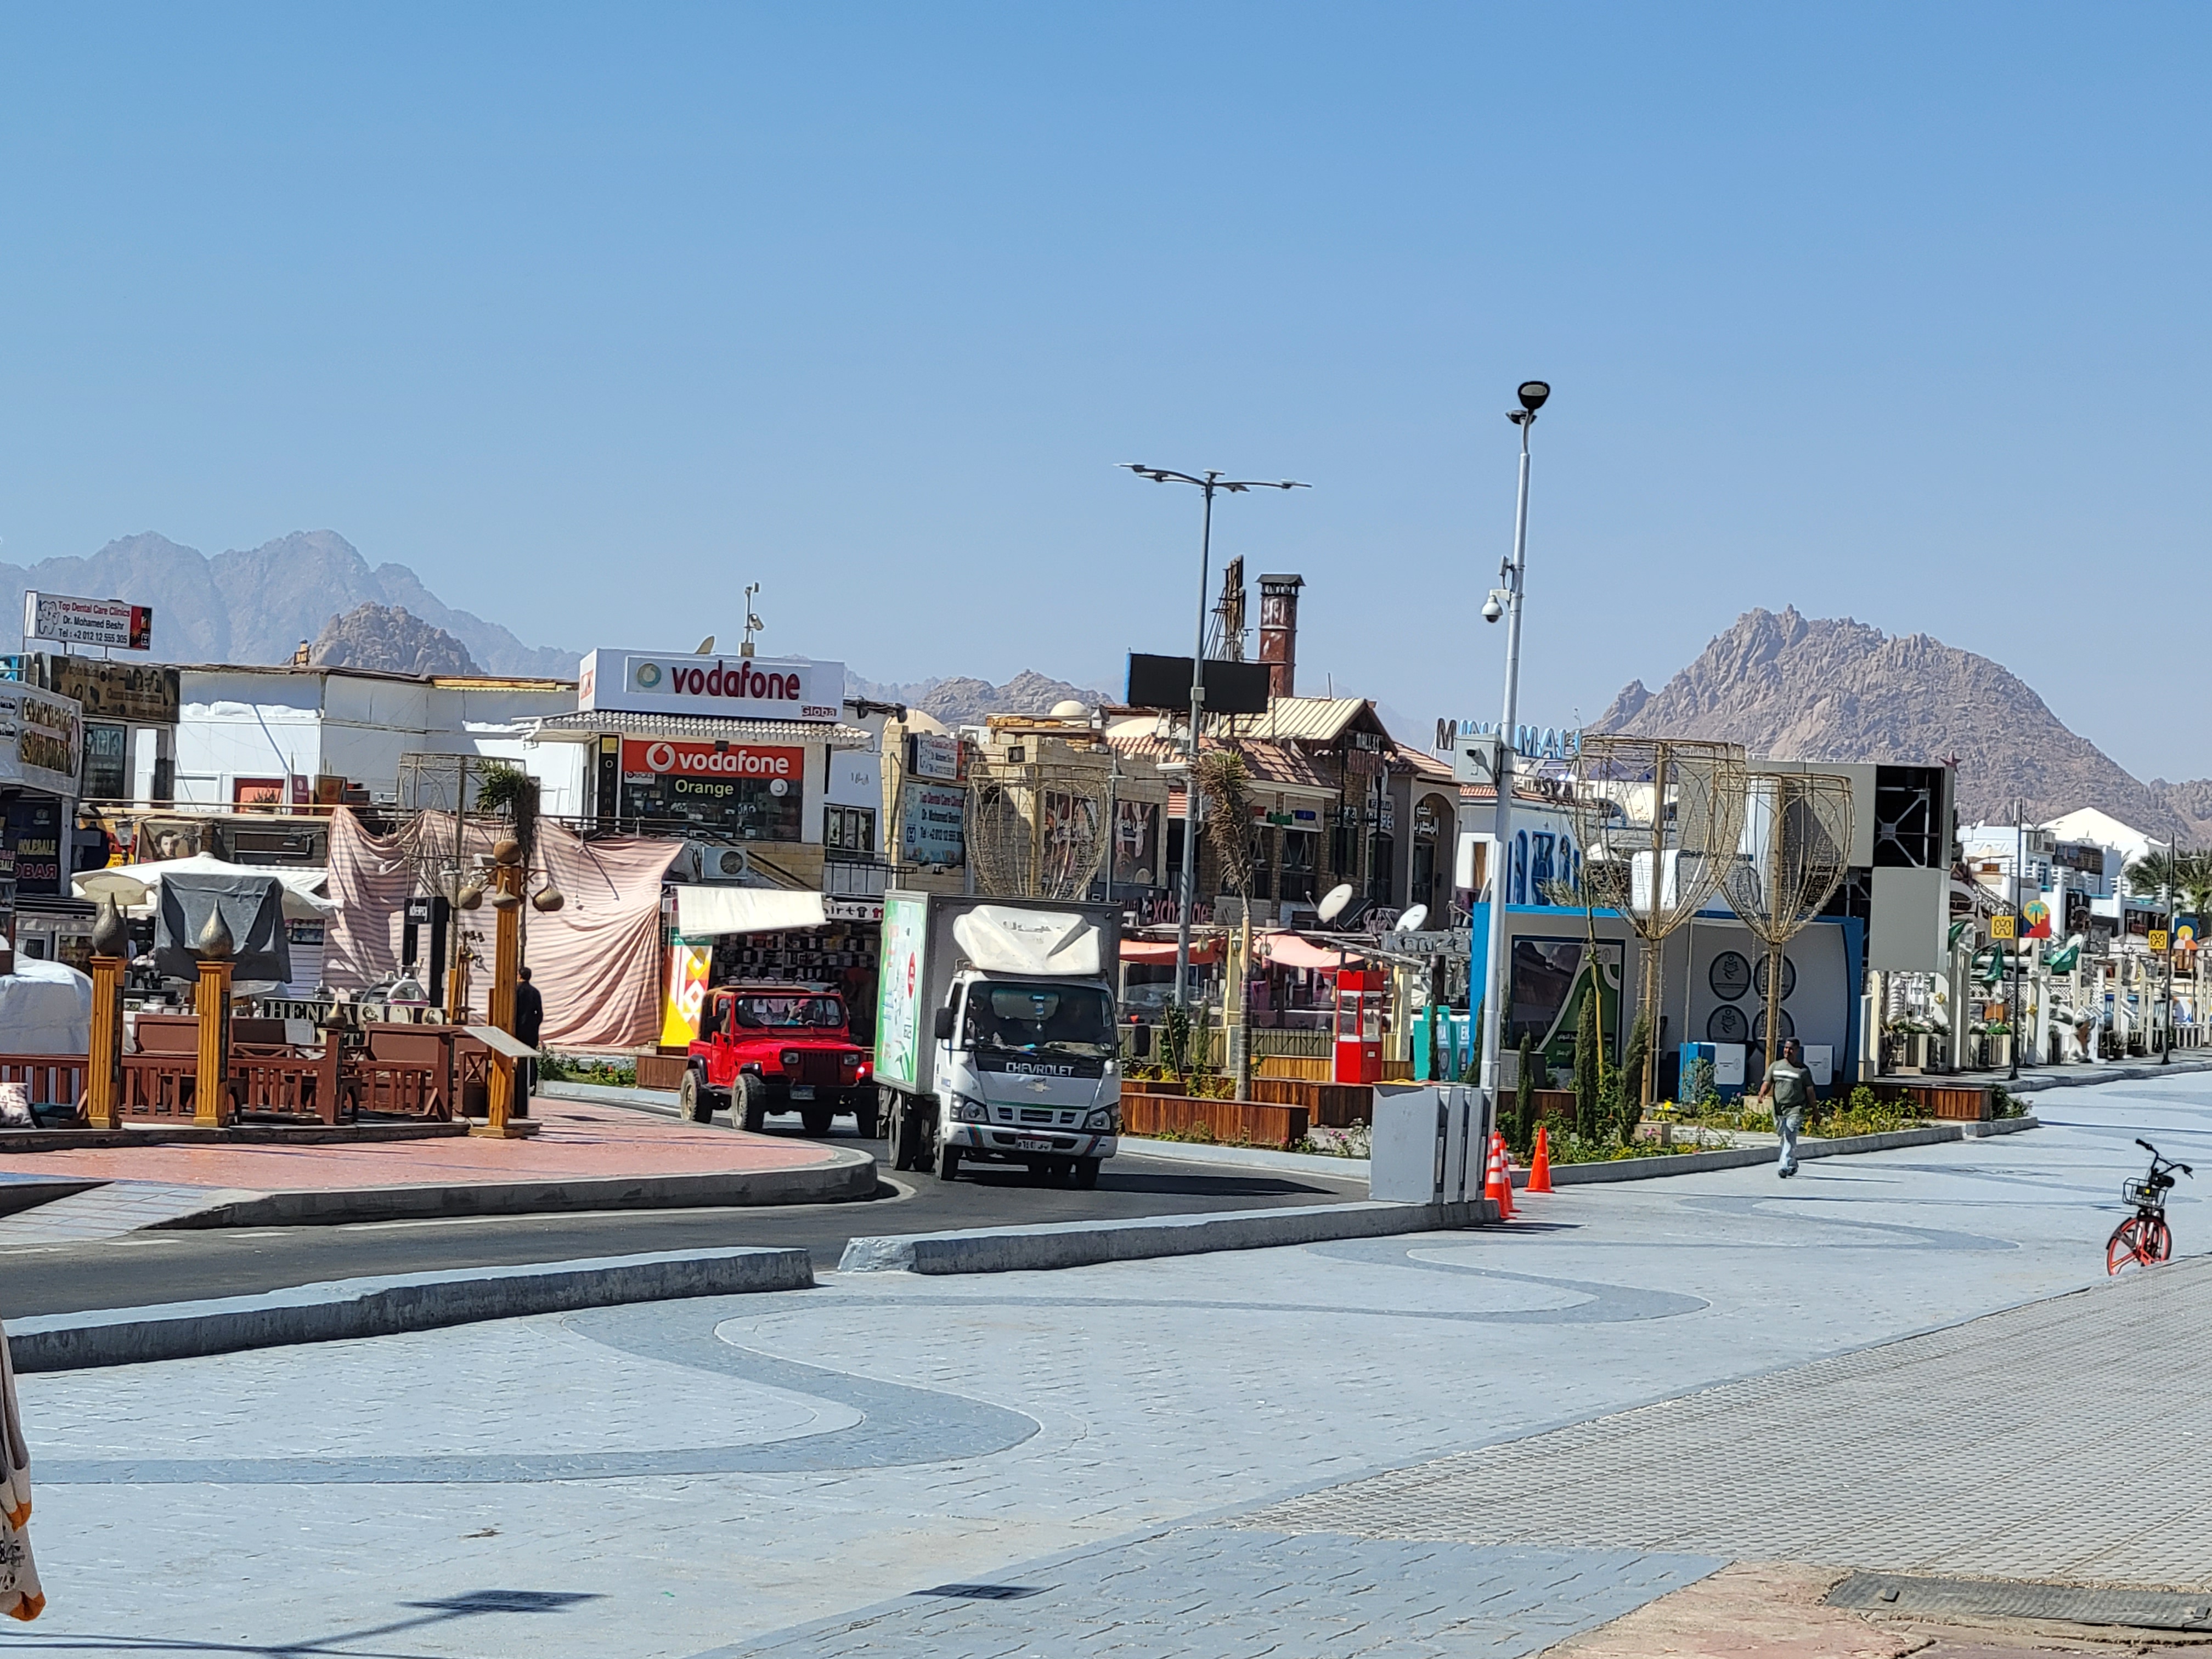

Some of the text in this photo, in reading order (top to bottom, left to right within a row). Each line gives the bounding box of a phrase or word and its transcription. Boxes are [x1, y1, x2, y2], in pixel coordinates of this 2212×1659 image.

[58, 601, 130, 617] Top Dental Care Clinics
[63, 616, 125, 630] Dr. Mohamed Beshr
[59, 628, 68, 637] Tel
[83, 631, 93, 641] 012
[95, 633, 103, 641] 12
[672, 660, 800, 700] vodafone
[679, 749, 789, 774] vodafone
[675, 779, 734, 798] Orange
[1006, 1062, 1075, 1076] CHEVROLET
